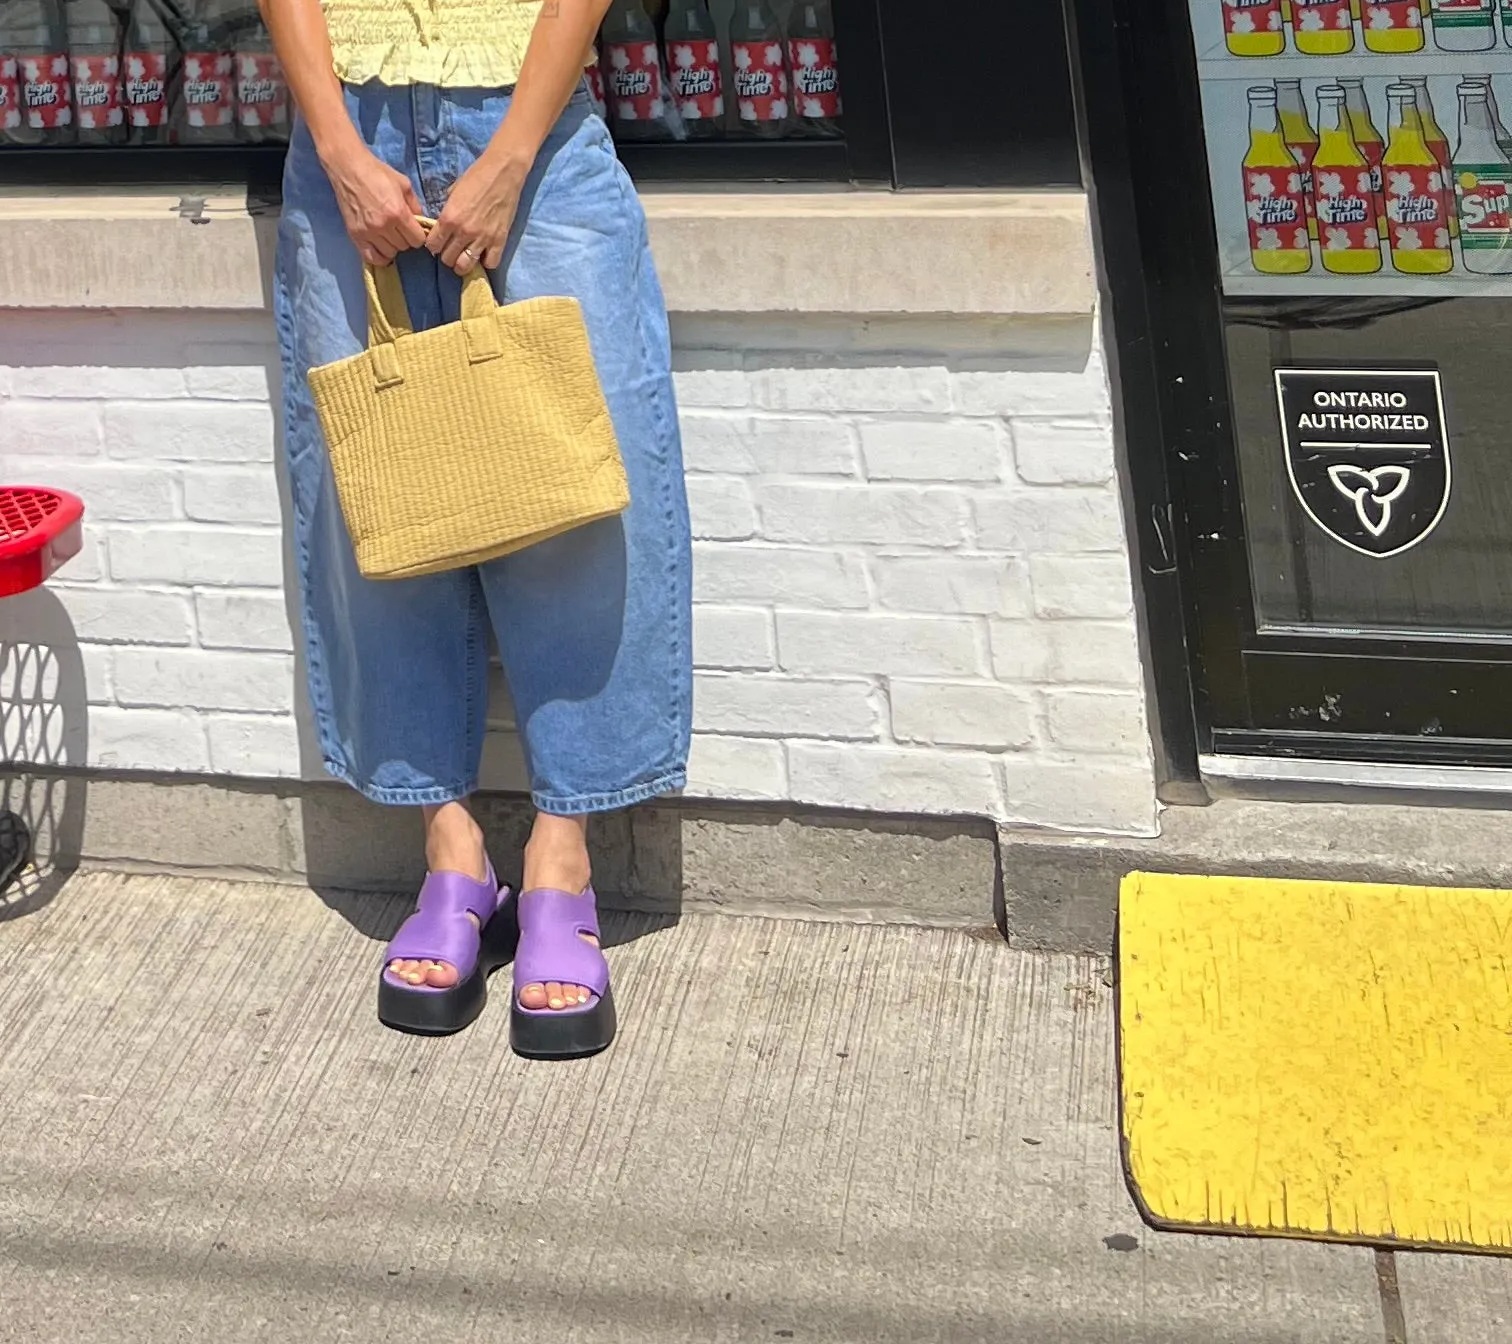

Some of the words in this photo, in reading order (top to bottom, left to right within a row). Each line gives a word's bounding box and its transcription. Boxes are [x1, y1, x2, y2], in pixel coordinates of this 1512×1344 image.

[680, 68, 710, 84] High
[802, 67, 836, 83] High
[679, 81, 713, 96] Time
[801, 80, 836, 95] Time
[1259, 196, 1292, 210] High
[1329, 195, 1362, 209] High
[1398, 194, 1433, 209] High
[1462, 193, 1509, 225] Sup
[1257, 209, 1296, 225] Time
[1326, 209, 1366, 224] Time
[1396, 209, 1436, 224] Time
[1313, 391, 1407, 408] ONTARIO
[1298, 413, 1429, 431] AUTHORIZED
